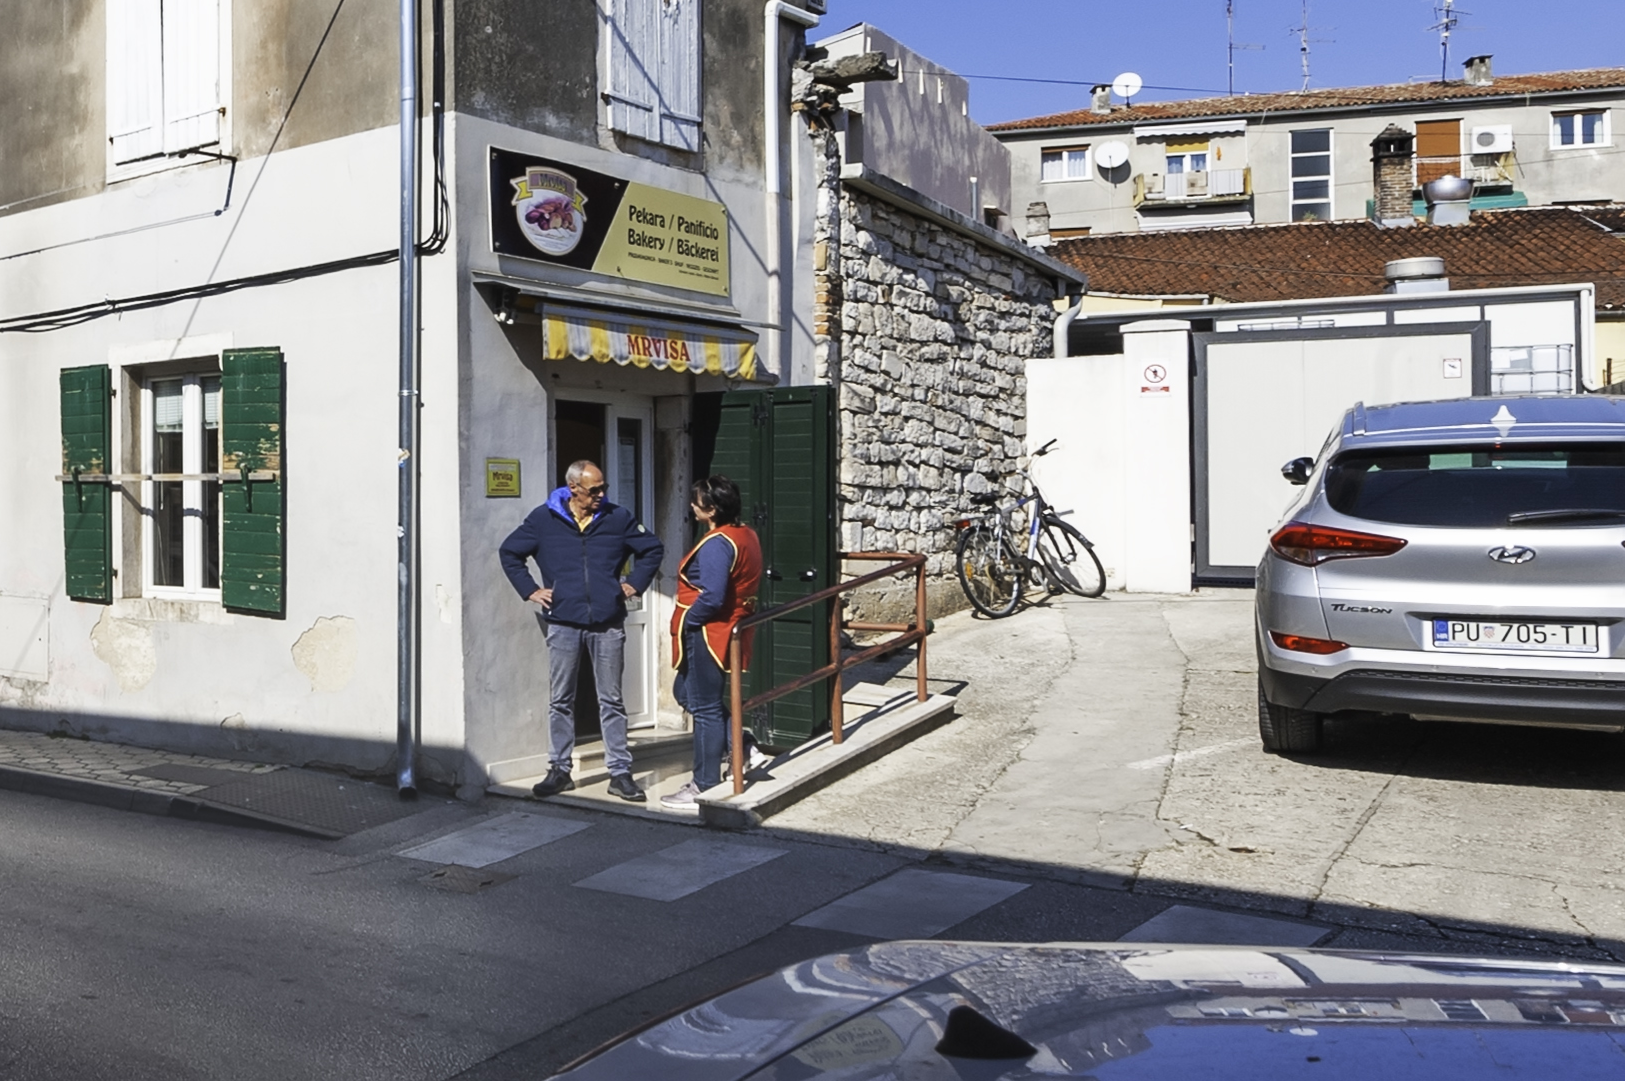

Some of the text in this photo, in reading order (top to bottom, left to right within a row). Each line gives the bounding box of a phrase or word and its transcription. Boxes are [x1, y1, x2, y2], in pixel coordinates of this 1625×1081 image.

[628, 204, 665, 228] Pekara
[677, 216, 719, 240] Panificio
[627, 228, 665, 251] Bakery
[626, 334, 692, 362] MRVISA
[1451, 622, 1587, 645] PU 705-TI
